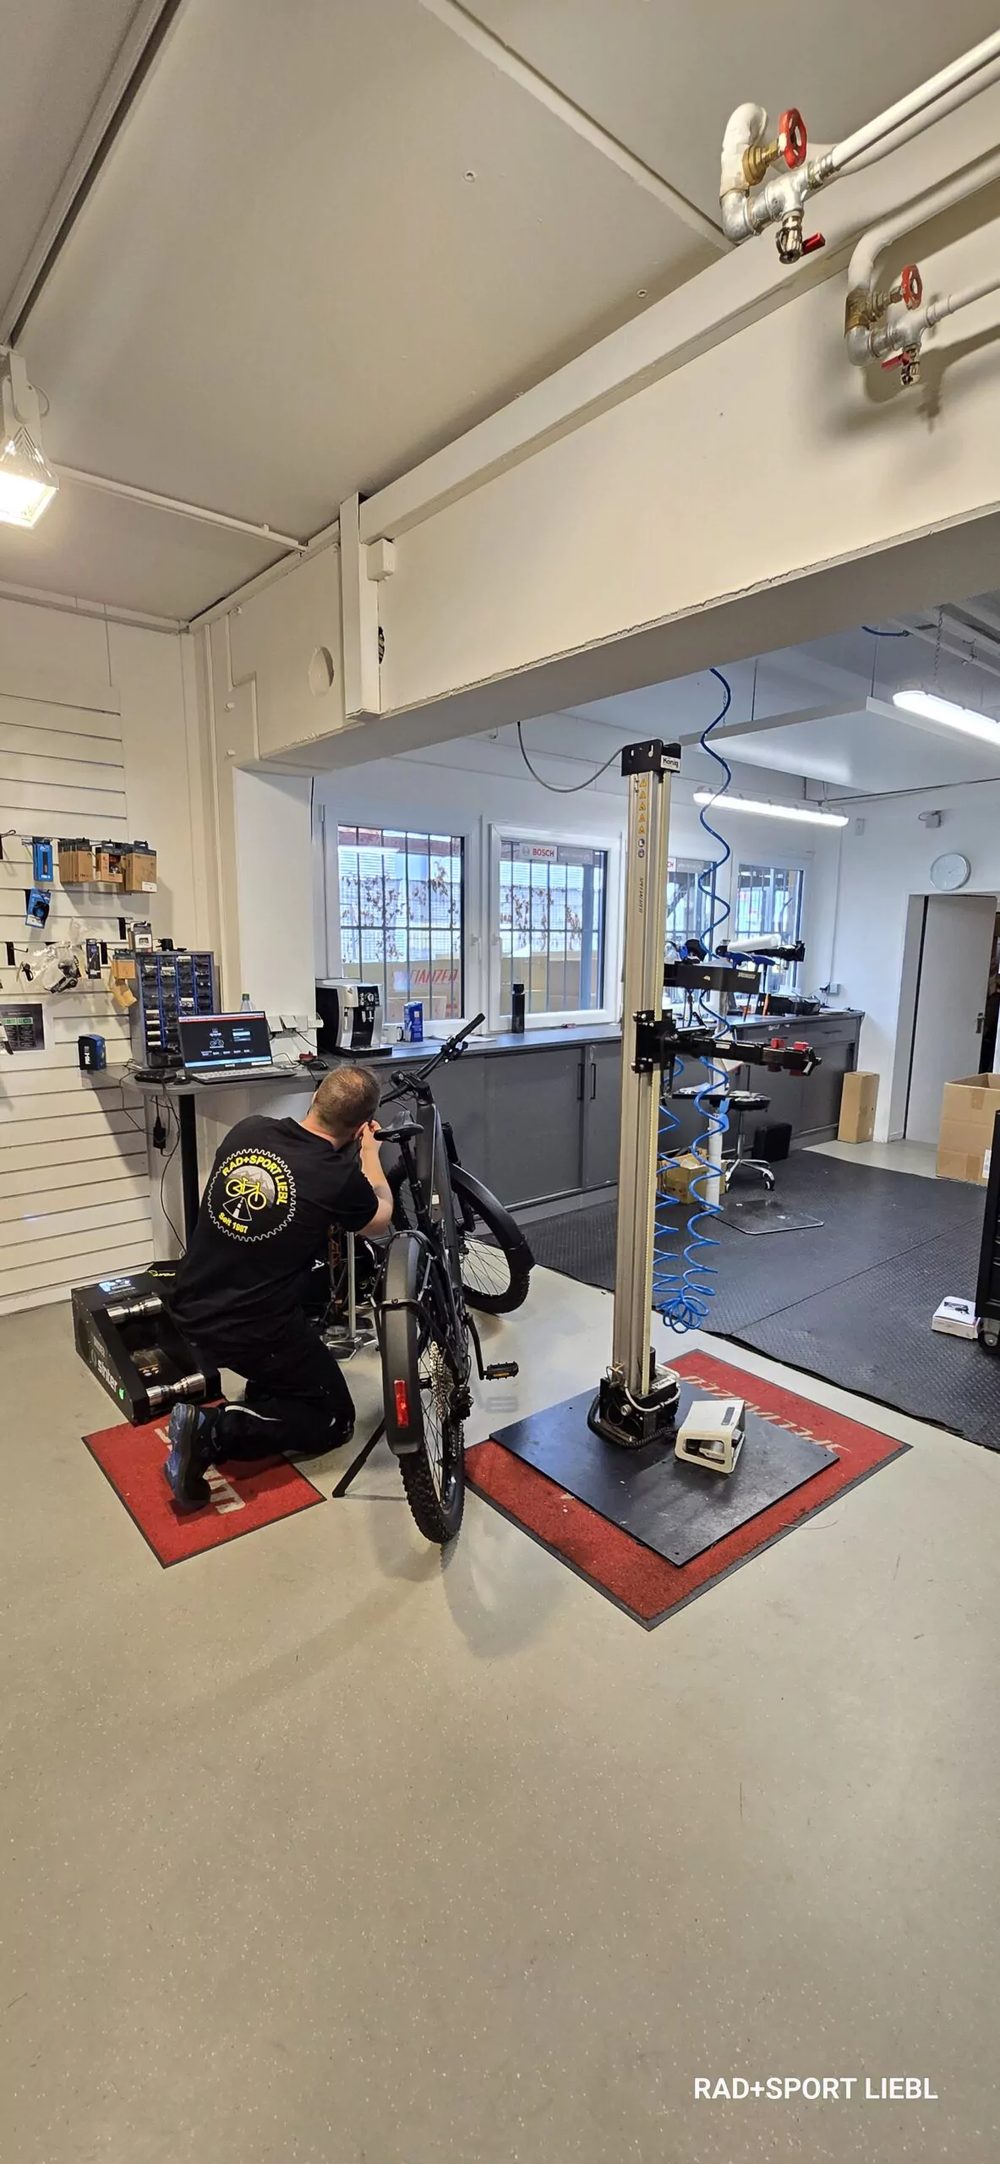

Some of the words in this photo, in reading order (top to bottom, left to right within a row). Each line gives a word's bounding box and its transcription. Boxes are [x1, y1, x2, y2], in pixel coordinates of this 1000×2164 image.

[532, 847, 555, 857] BOSCH
[222, 1155, 282, 1176] RAD+SPORT
[275, 1175, 289, 1205] LIEBL
[218, 1212, 232, 1226] Seit
